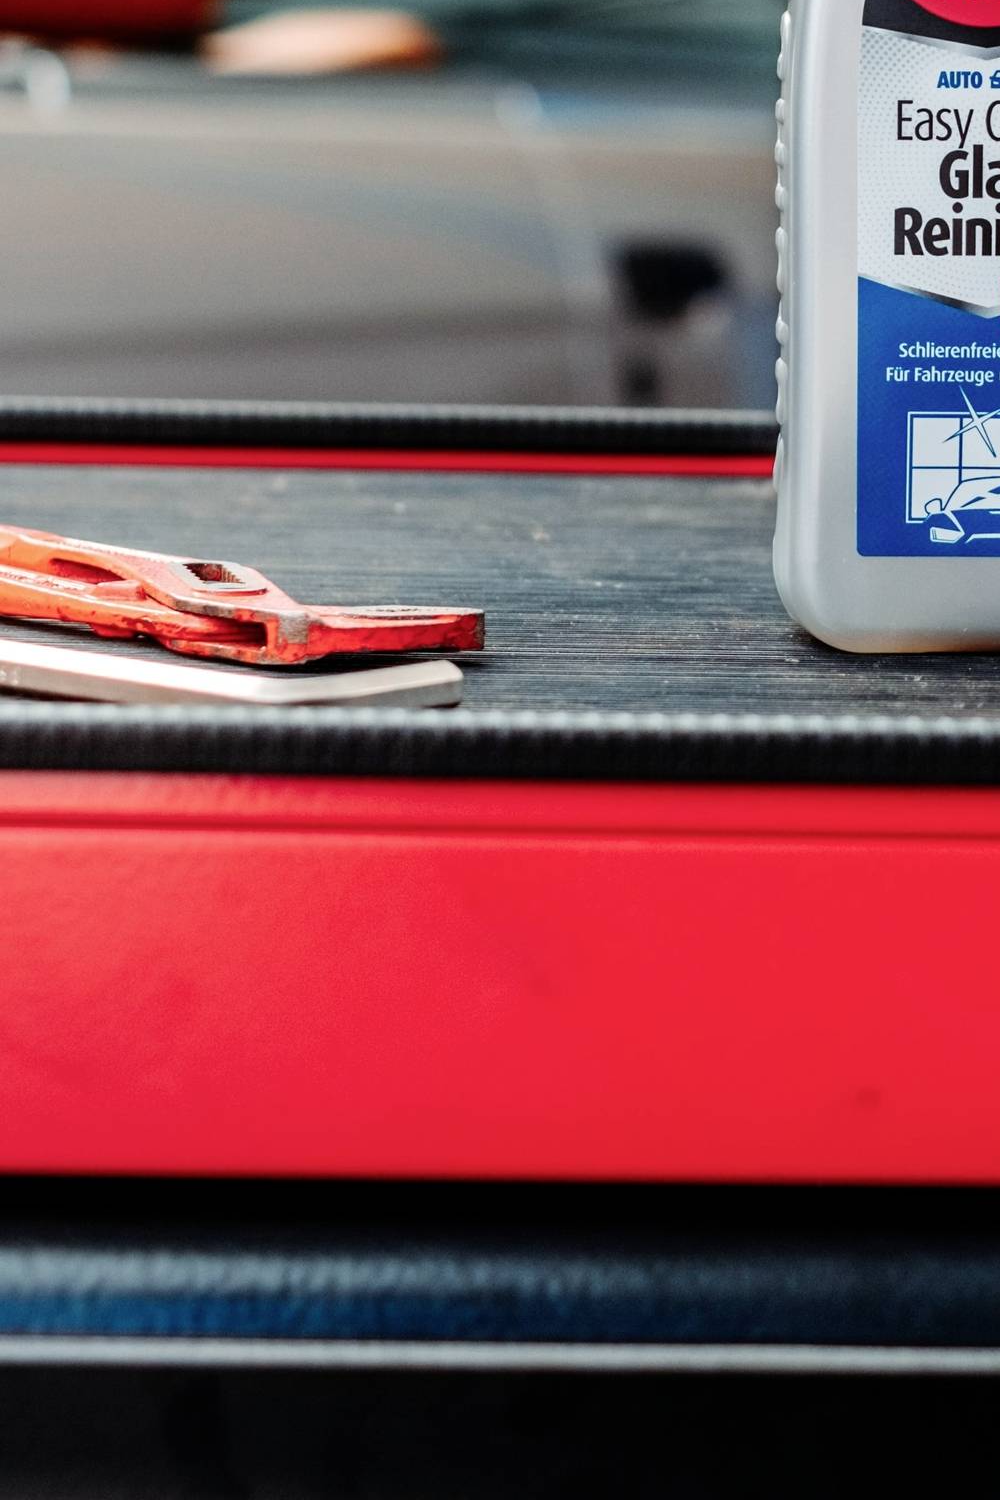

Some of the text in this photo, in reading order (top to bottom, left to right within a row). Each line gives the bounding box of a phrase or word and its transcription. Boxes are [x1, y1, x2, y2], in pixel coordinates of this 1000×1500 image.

[937, 71, 983, 89] AUTO
[896, 99, 974, 149] Easy
[886, 366, 910, 382] Für
[914, 367, 994, 386] Fahrzeuge
